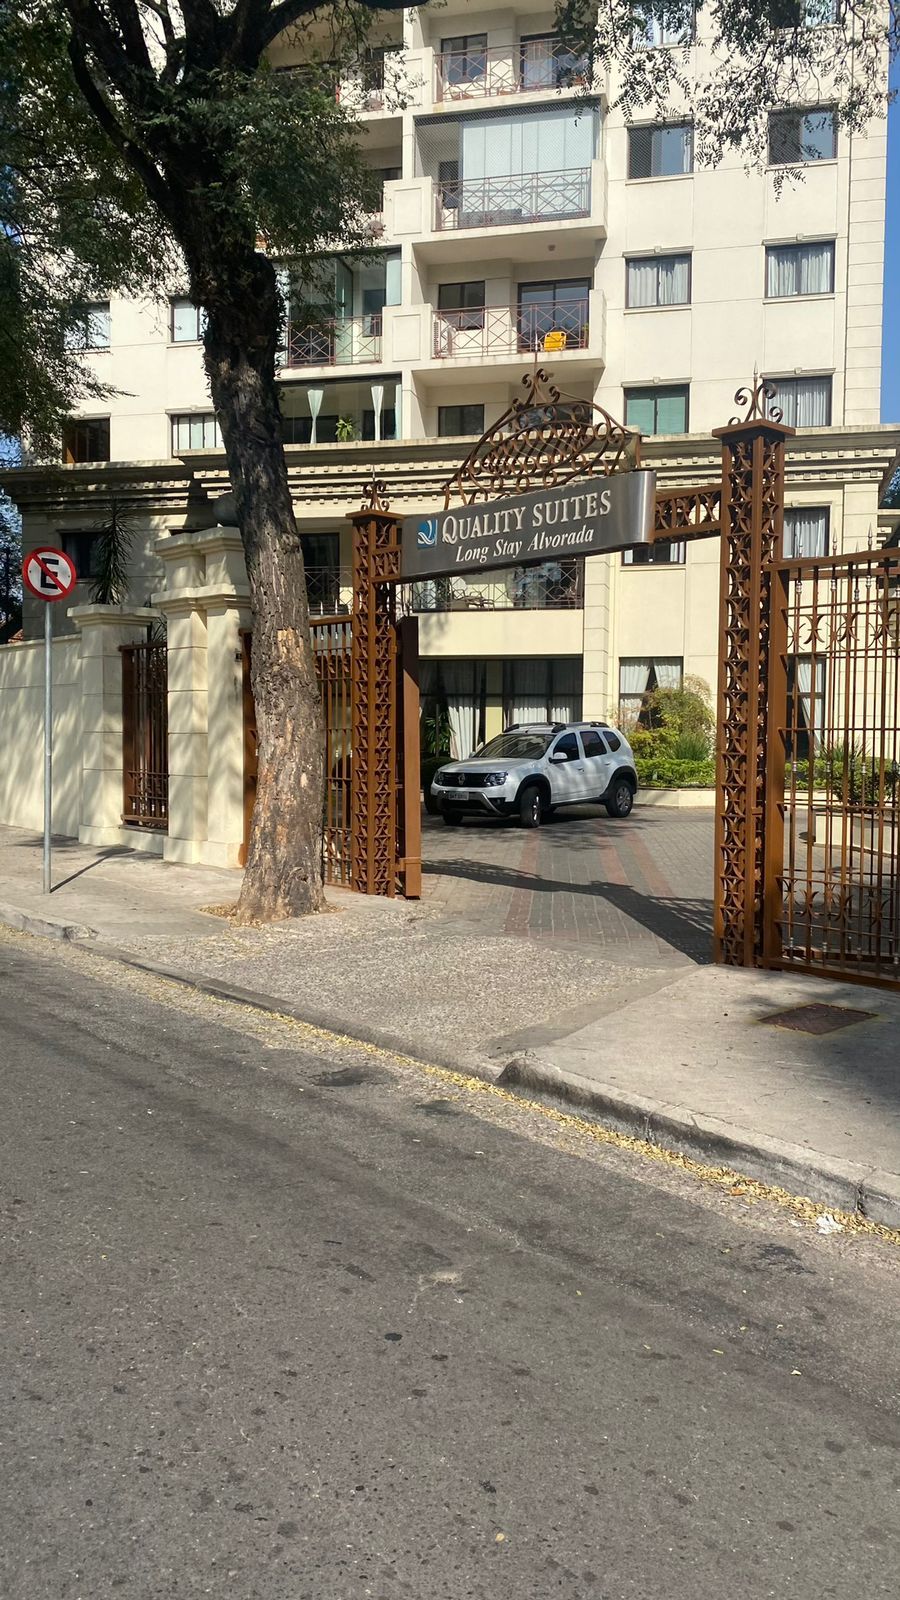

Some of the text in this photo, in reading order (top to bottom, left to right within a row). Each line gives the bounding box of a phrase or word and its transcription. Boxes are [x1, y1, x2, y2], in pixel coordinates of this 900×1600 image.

[442, 490, 611, 545] QUALITY SUITES
[456, 525, 595, 563] Long Stay Alvorada
[40, 557, 59, 590] E
